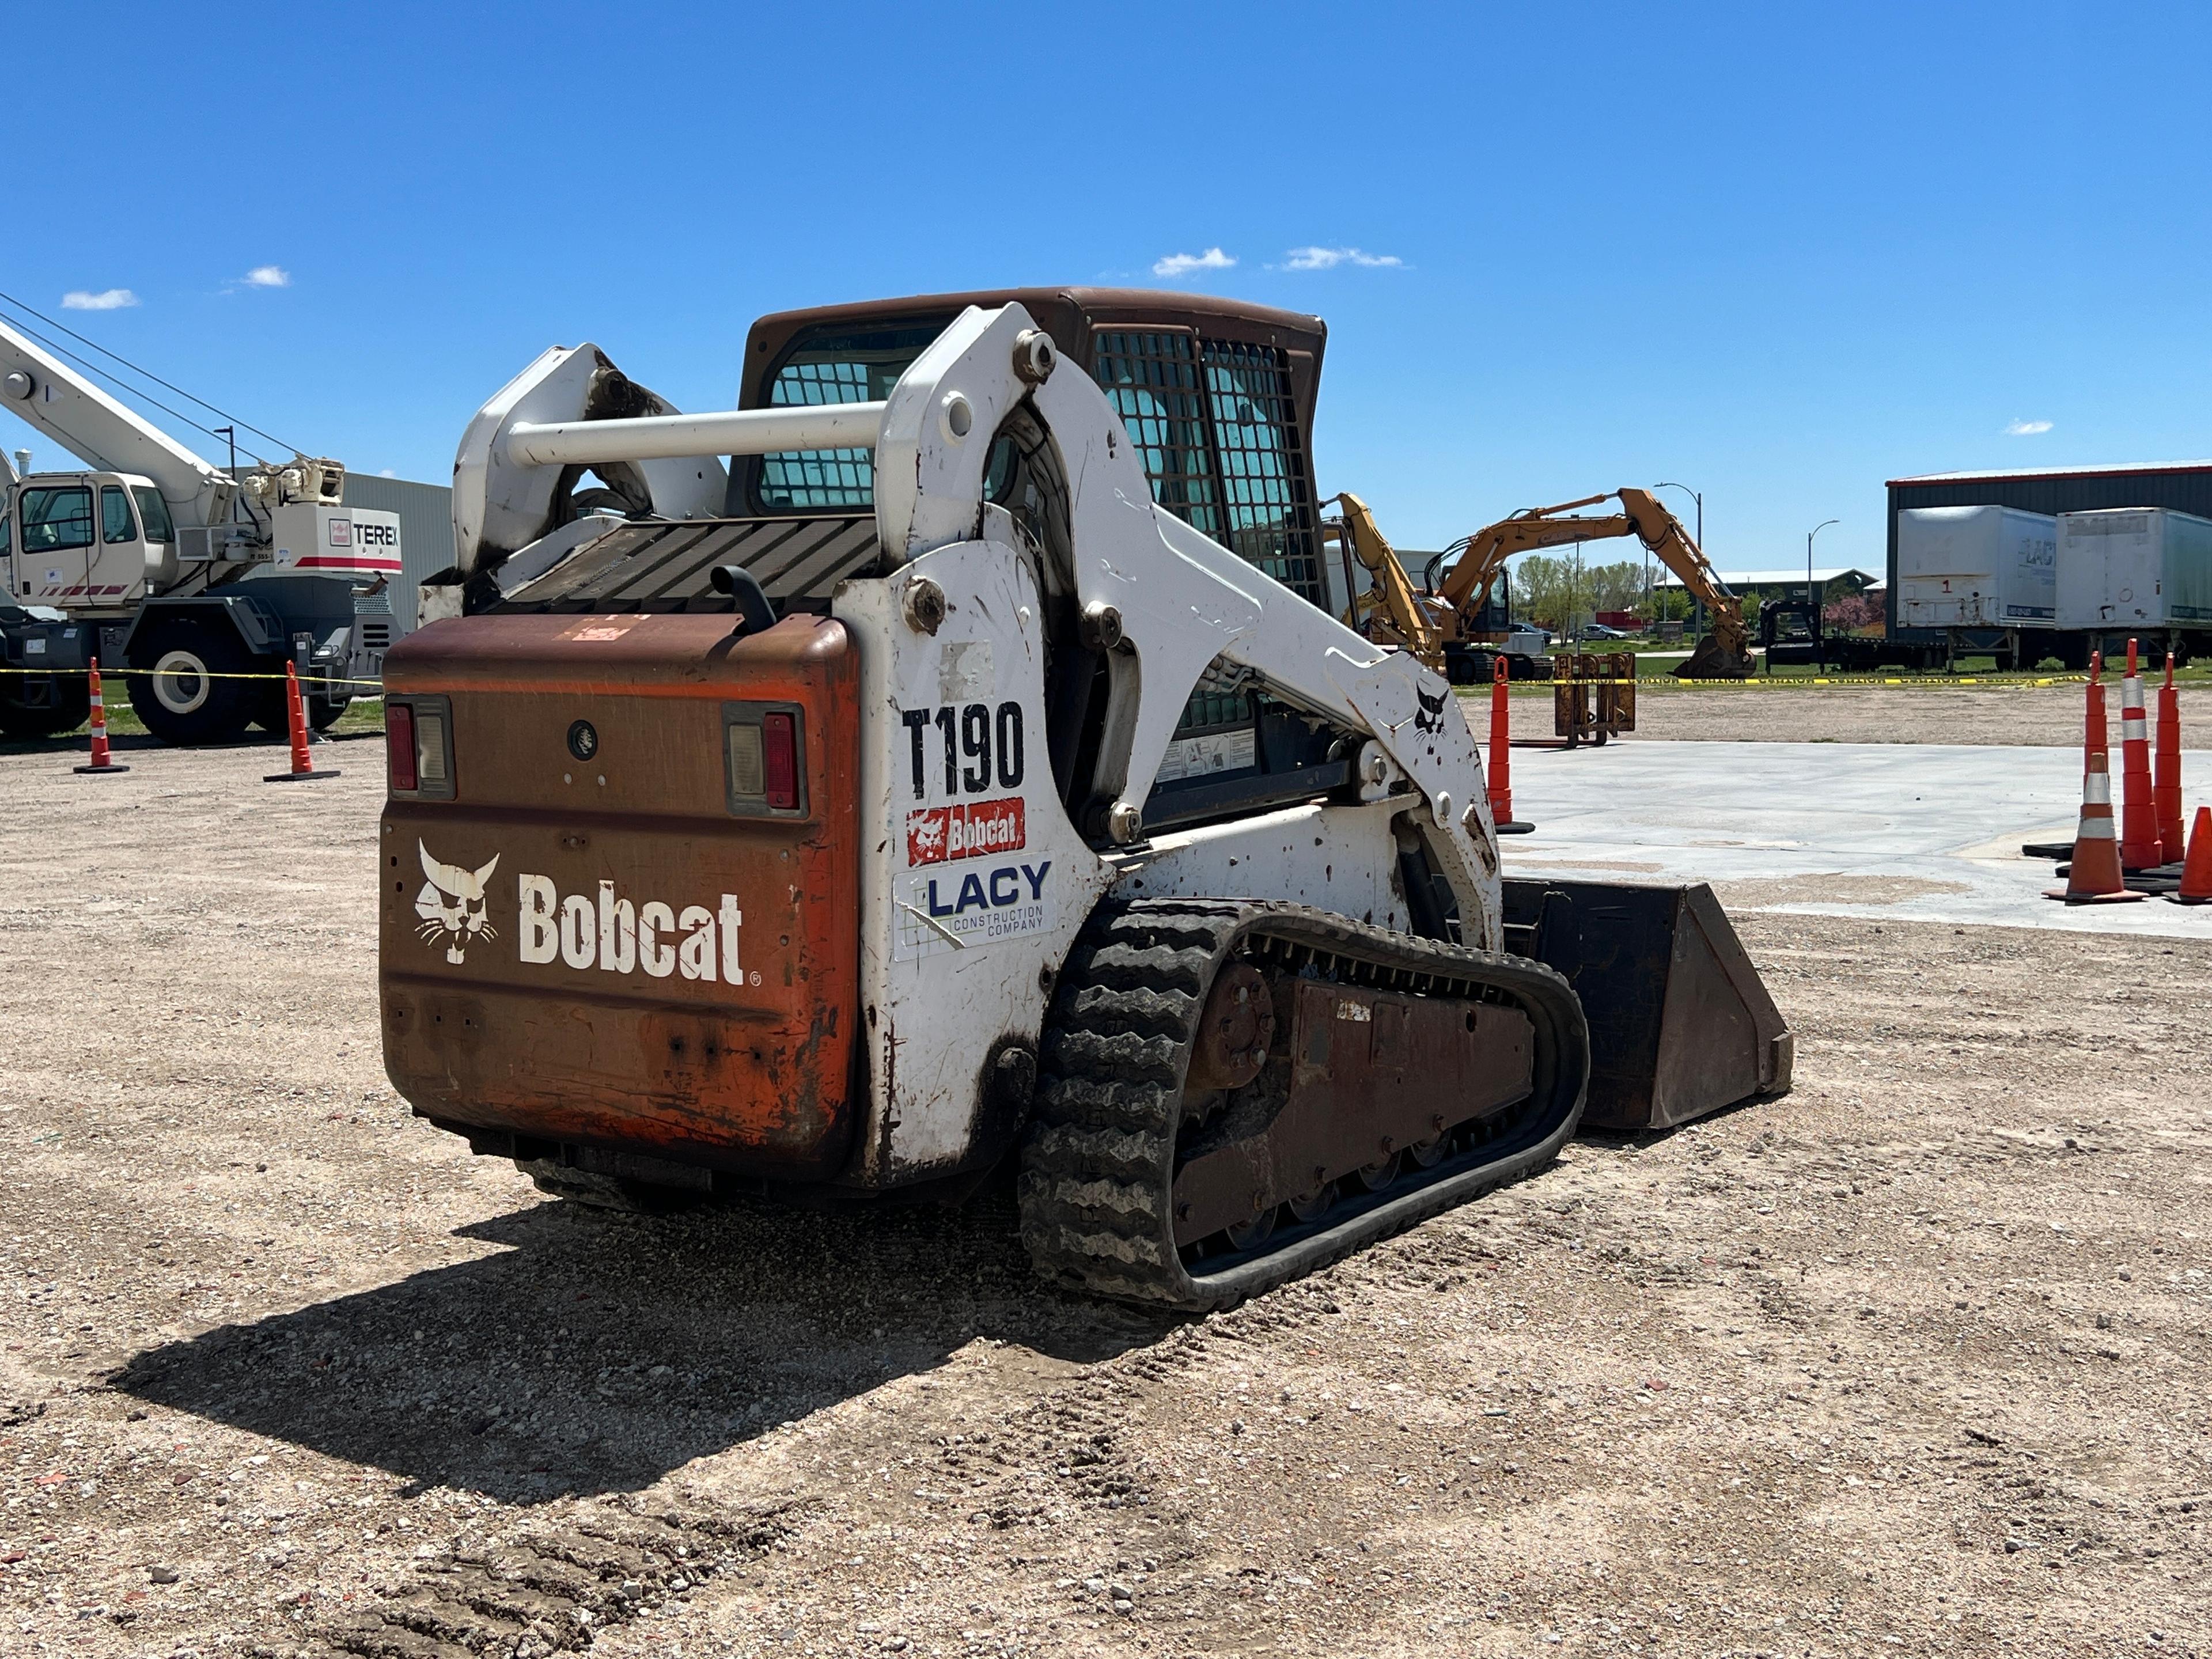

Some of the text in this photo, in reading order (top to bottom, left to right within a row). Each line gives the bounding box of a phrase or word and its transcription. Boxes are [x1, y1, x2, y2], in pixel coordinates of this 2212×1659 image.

[354, 524, 398, 547] TEREX
[1942, 579, 1952, 593] 1
[902, 700, 1024, 800] T190
[950, 812, 1016, 851] Bobcat
[929, 861, 1052, 917] LACY
[518, 873, 744, 986] Bobcat
[954, 905, 1043, 931] CONSTRUCTION
[987, 916, 1044, 937] COMPANY
